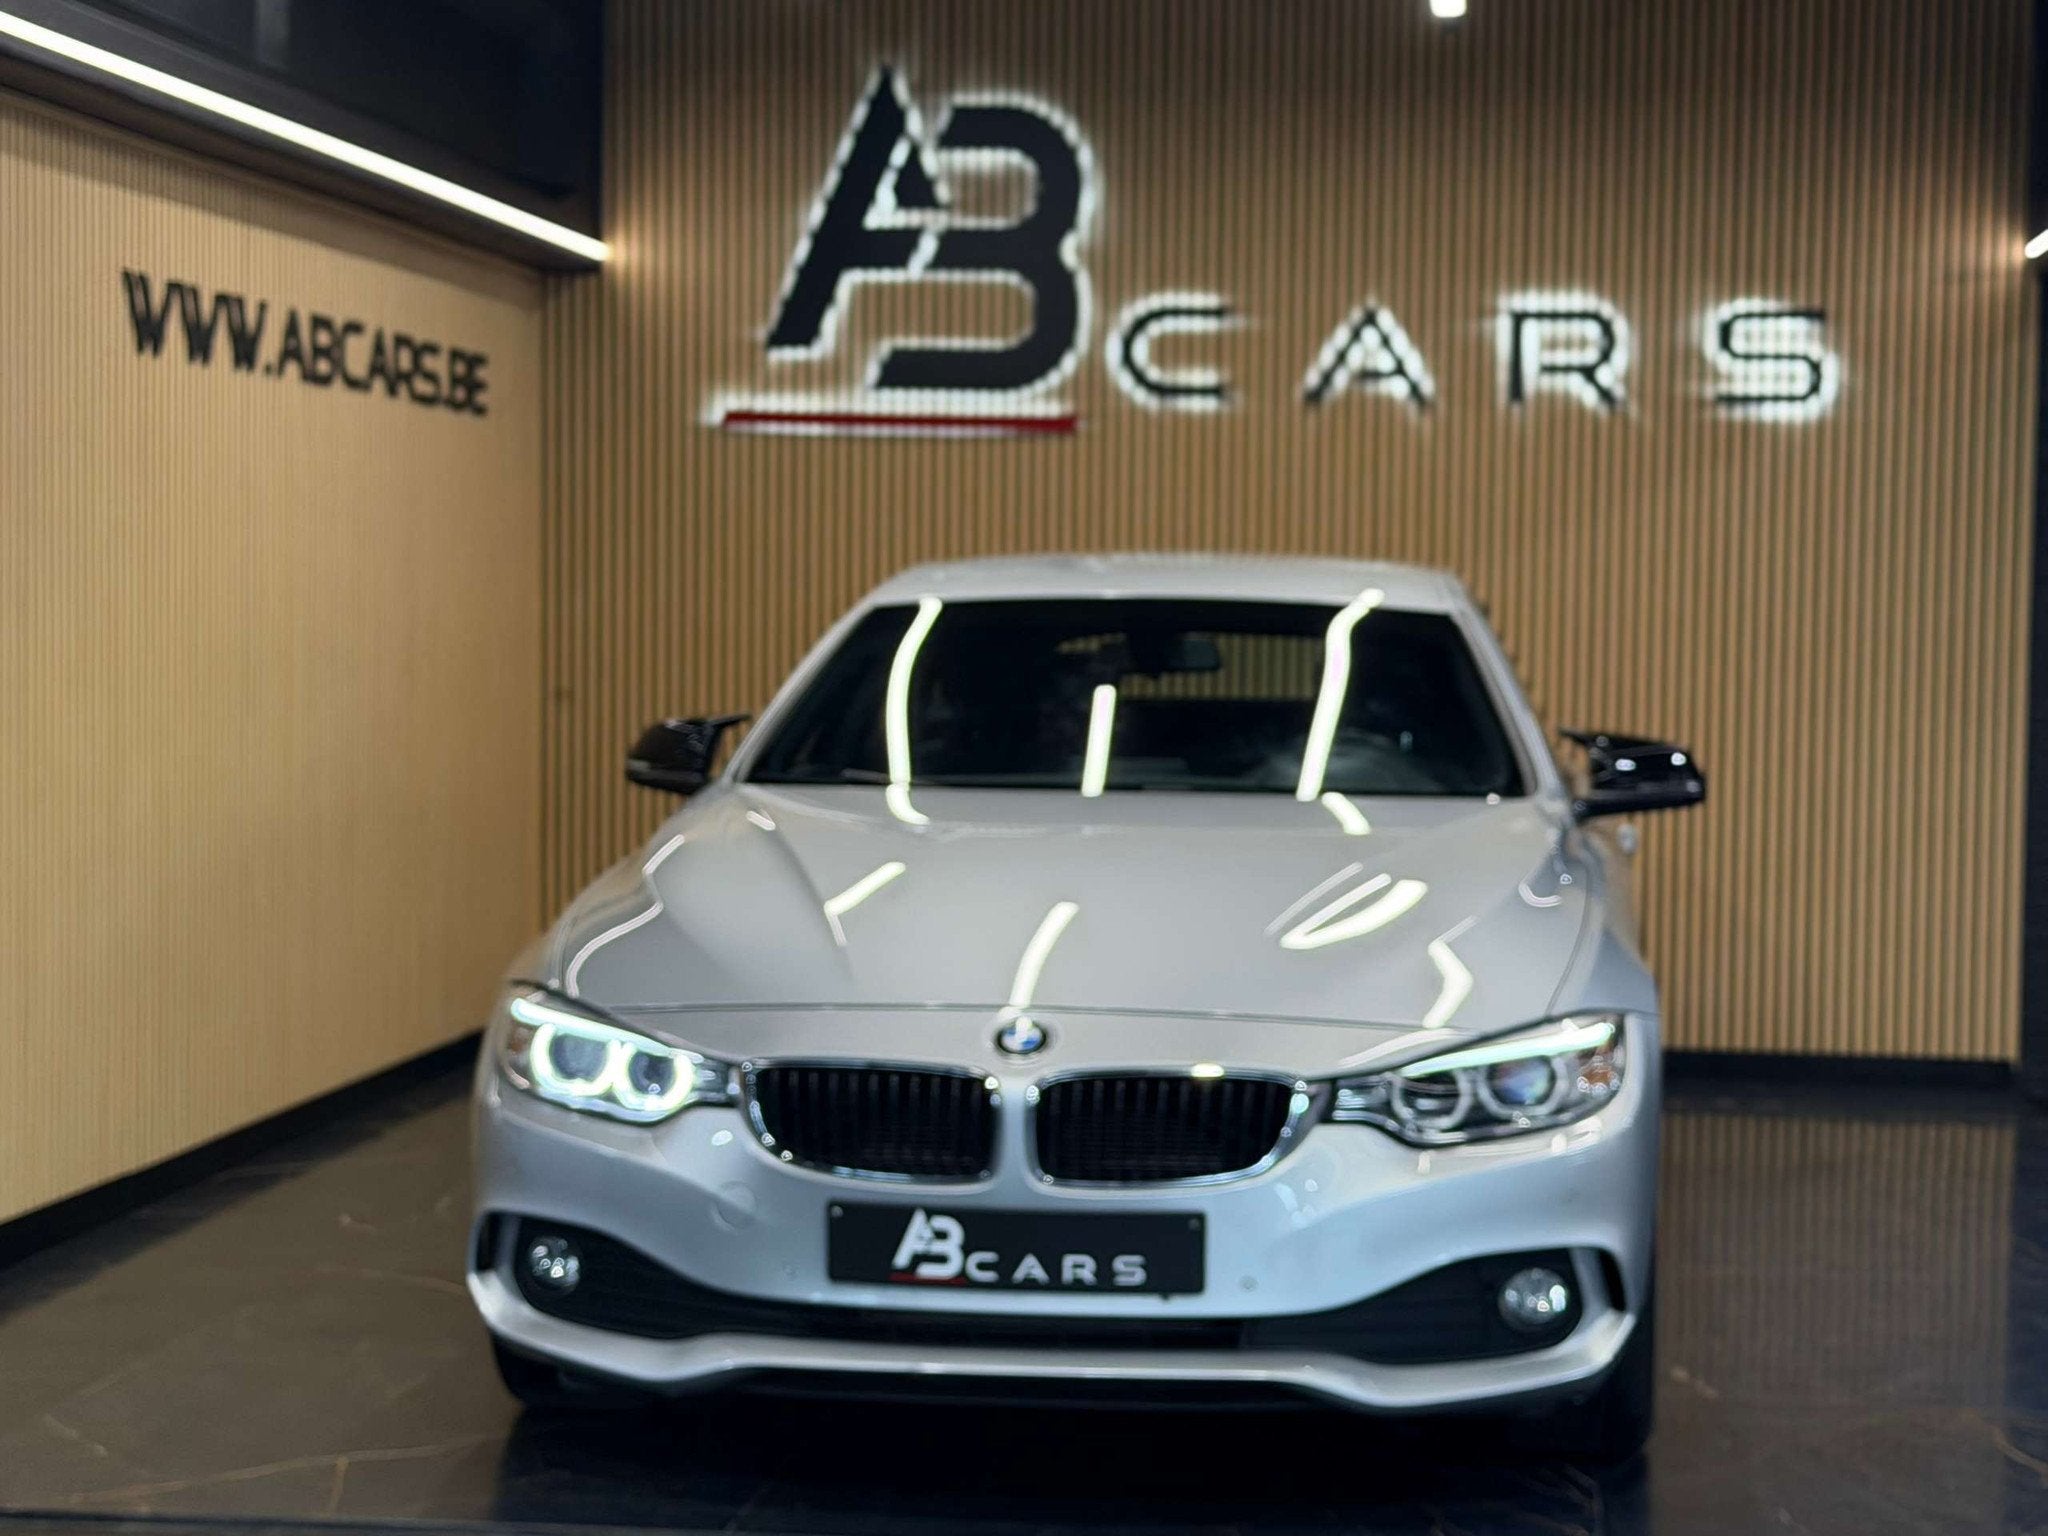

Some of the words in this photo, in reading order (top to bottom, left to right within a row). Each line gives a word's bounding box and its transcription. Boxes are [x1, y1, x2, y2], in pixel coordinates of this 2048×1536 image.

[122, 266, 489, 416] WWW.ABCARS.BE
[1114, 296, 1834, 412] CARS
[965, 1251, 1148, 1288] CARS
